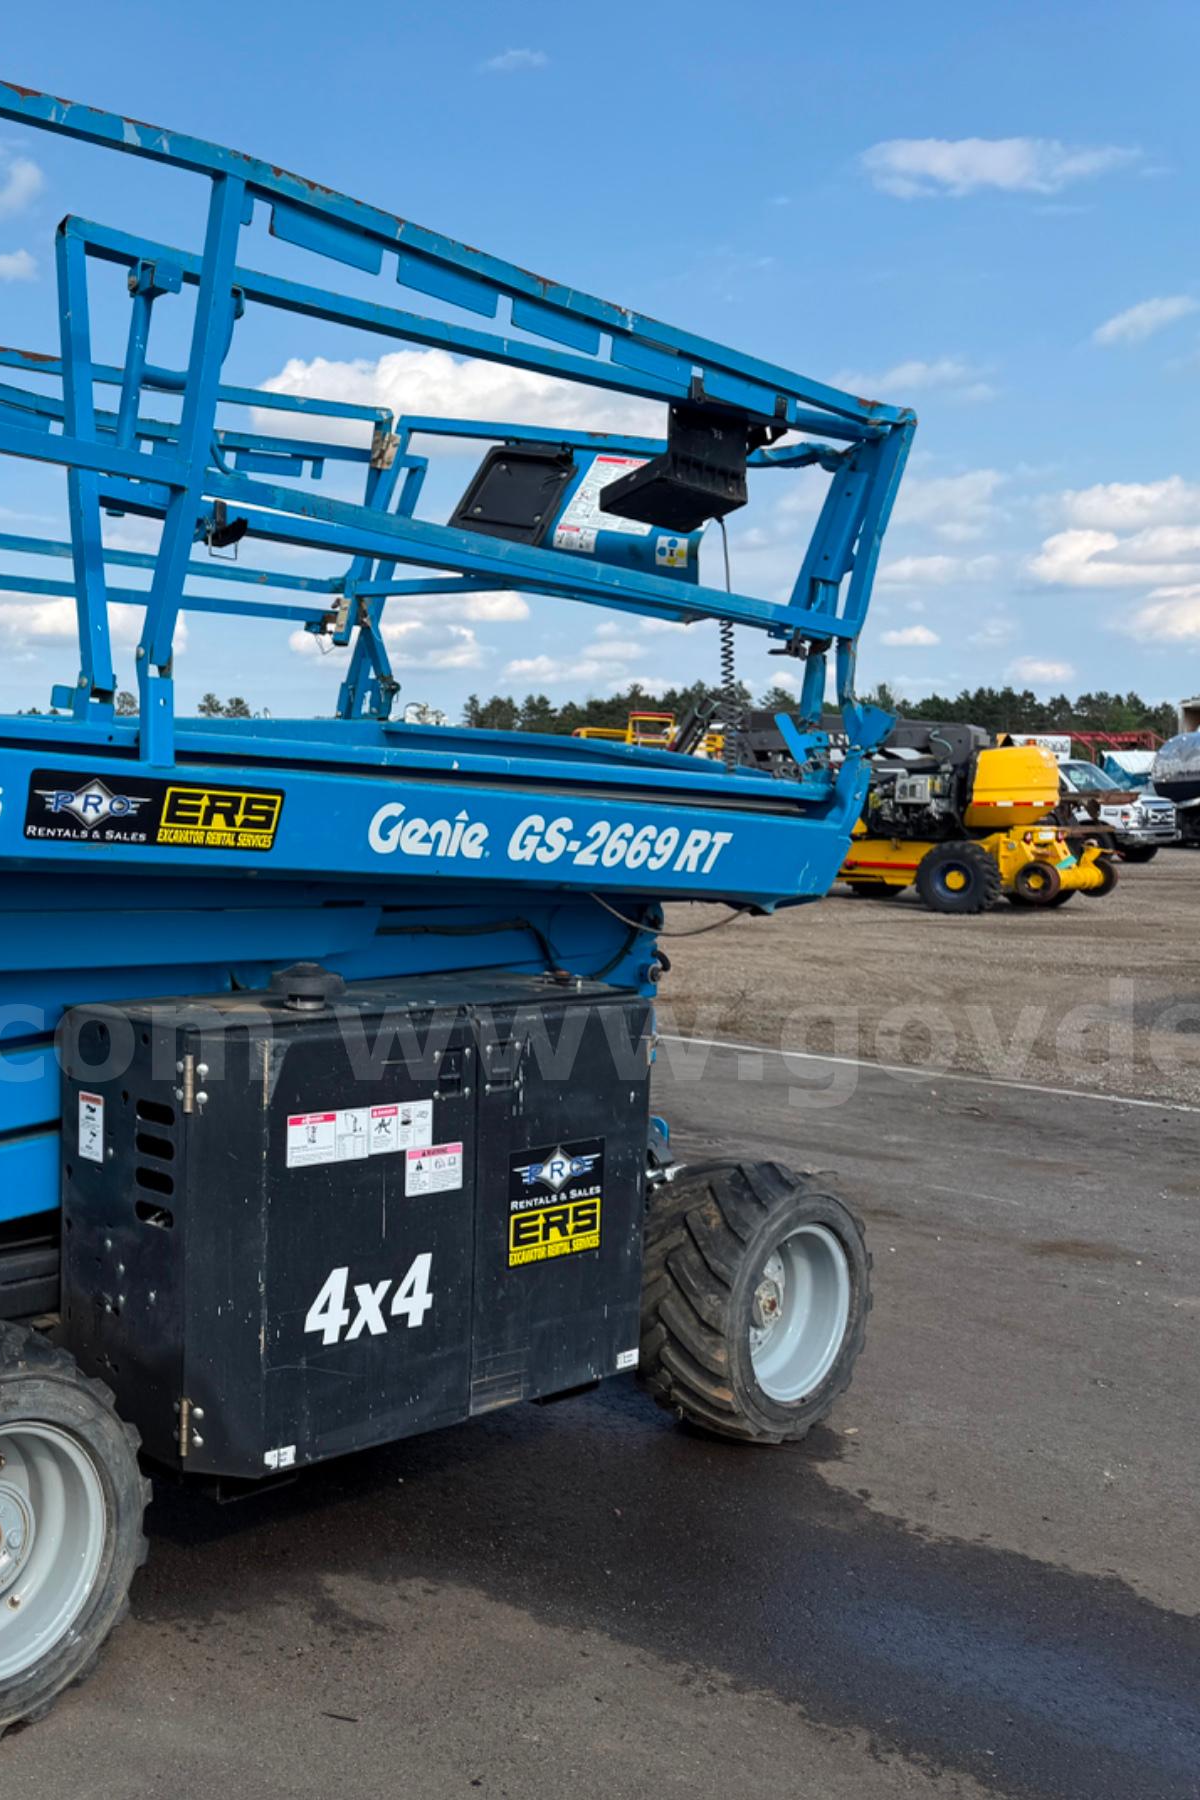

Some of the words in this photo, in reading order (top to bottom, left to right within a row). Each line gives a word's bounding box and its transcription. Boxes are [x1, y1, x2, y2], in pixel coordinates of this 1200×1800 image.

[51, 790, 130, 817] PRO
[163, 790, 278, 831] ERS
[26, 824, 88, 839] RENTALS
[92, 830, 100, 839] &
[105, 829, 147, 842] SALES
[157, 828, 205, 844] EXCAVATOR
[205, 831, 236, 847] RENTAL
[368, 802, 490, 858] Genie
[511, 1194, 557, 1211] RENTALS
[559, 1192, 567, 1200] &
[569, 1185, 601, 1199] SALES
[512, 1202, 597, 1246] ERS
[304, 1252, 433, 1345] 4x4
